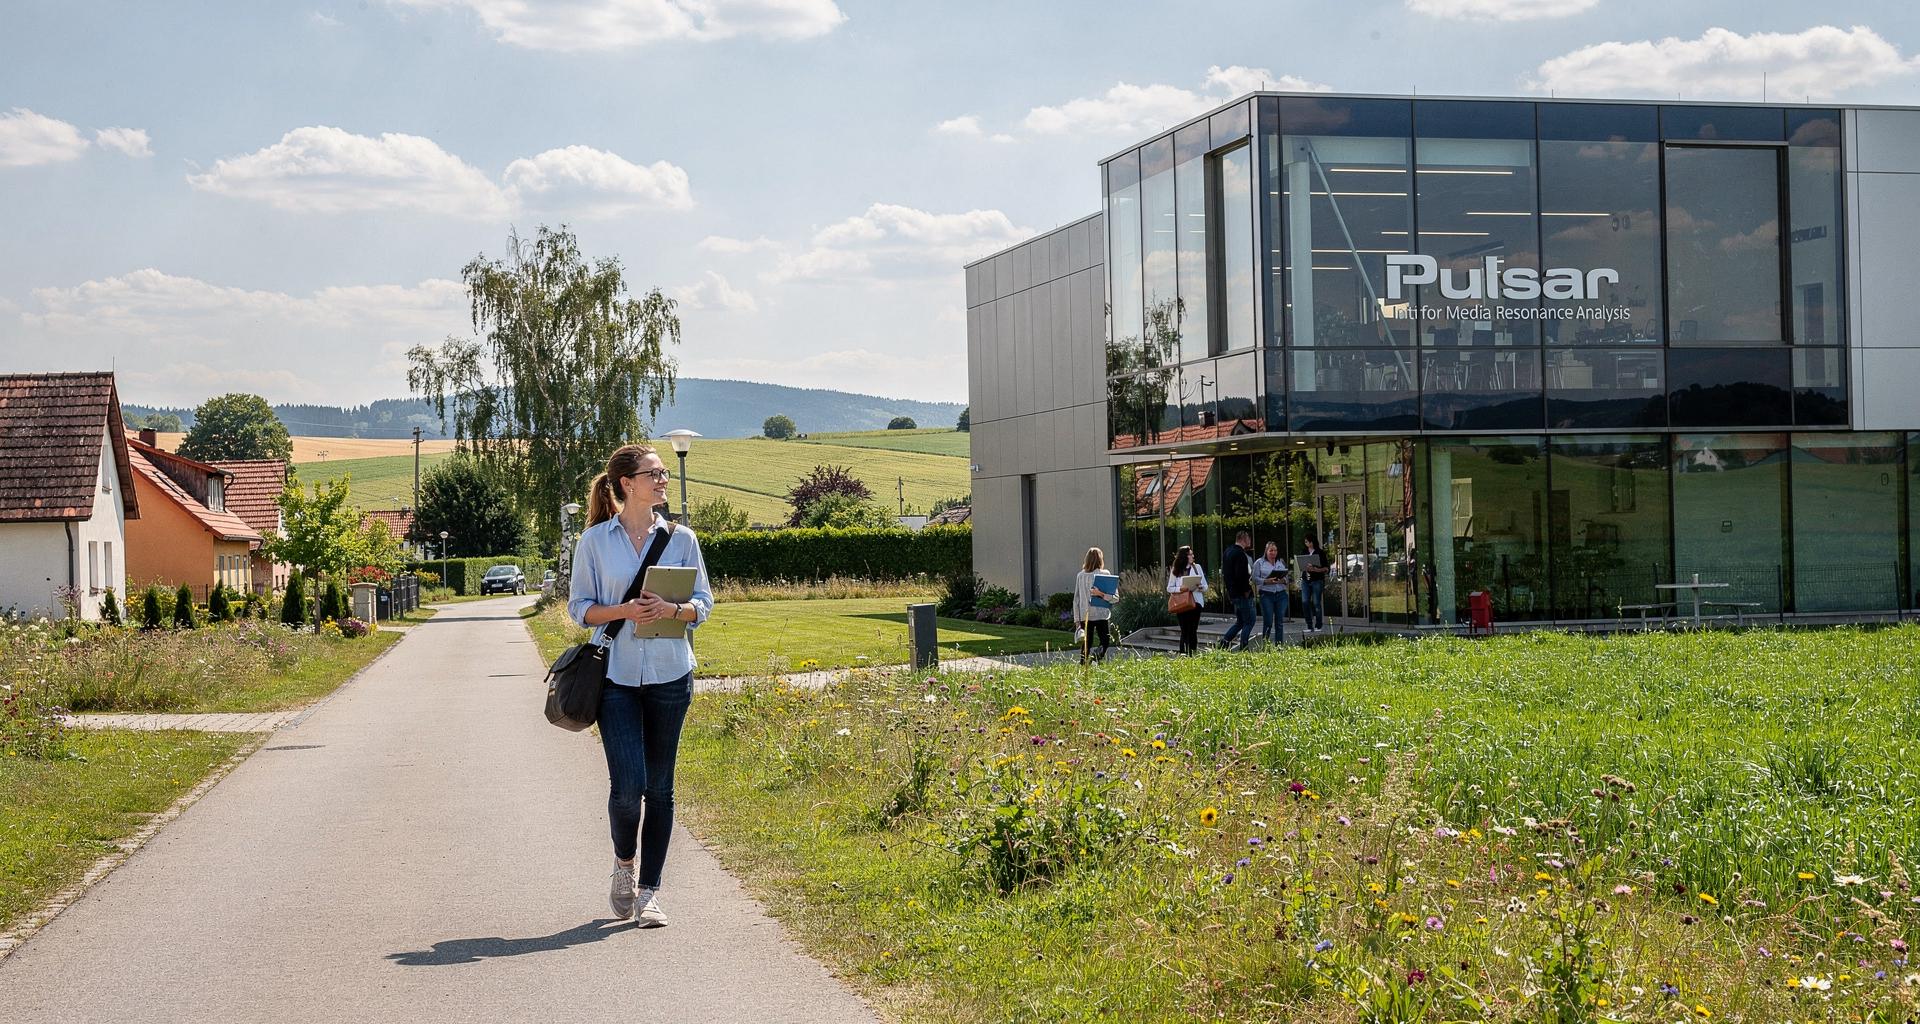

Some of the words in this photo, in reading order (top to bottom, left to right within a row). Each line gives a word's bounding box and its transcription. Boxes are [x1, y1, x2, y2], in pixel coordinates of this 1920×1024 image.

[1386, 254, 1619, 300] Pulsar
[1420, 305, 1442, 320] for
[1446, 305, 1491, 320] Media
[1496, 305, 1574, 320] Resonance
[1576, 304, 1631, 323] Analysis
